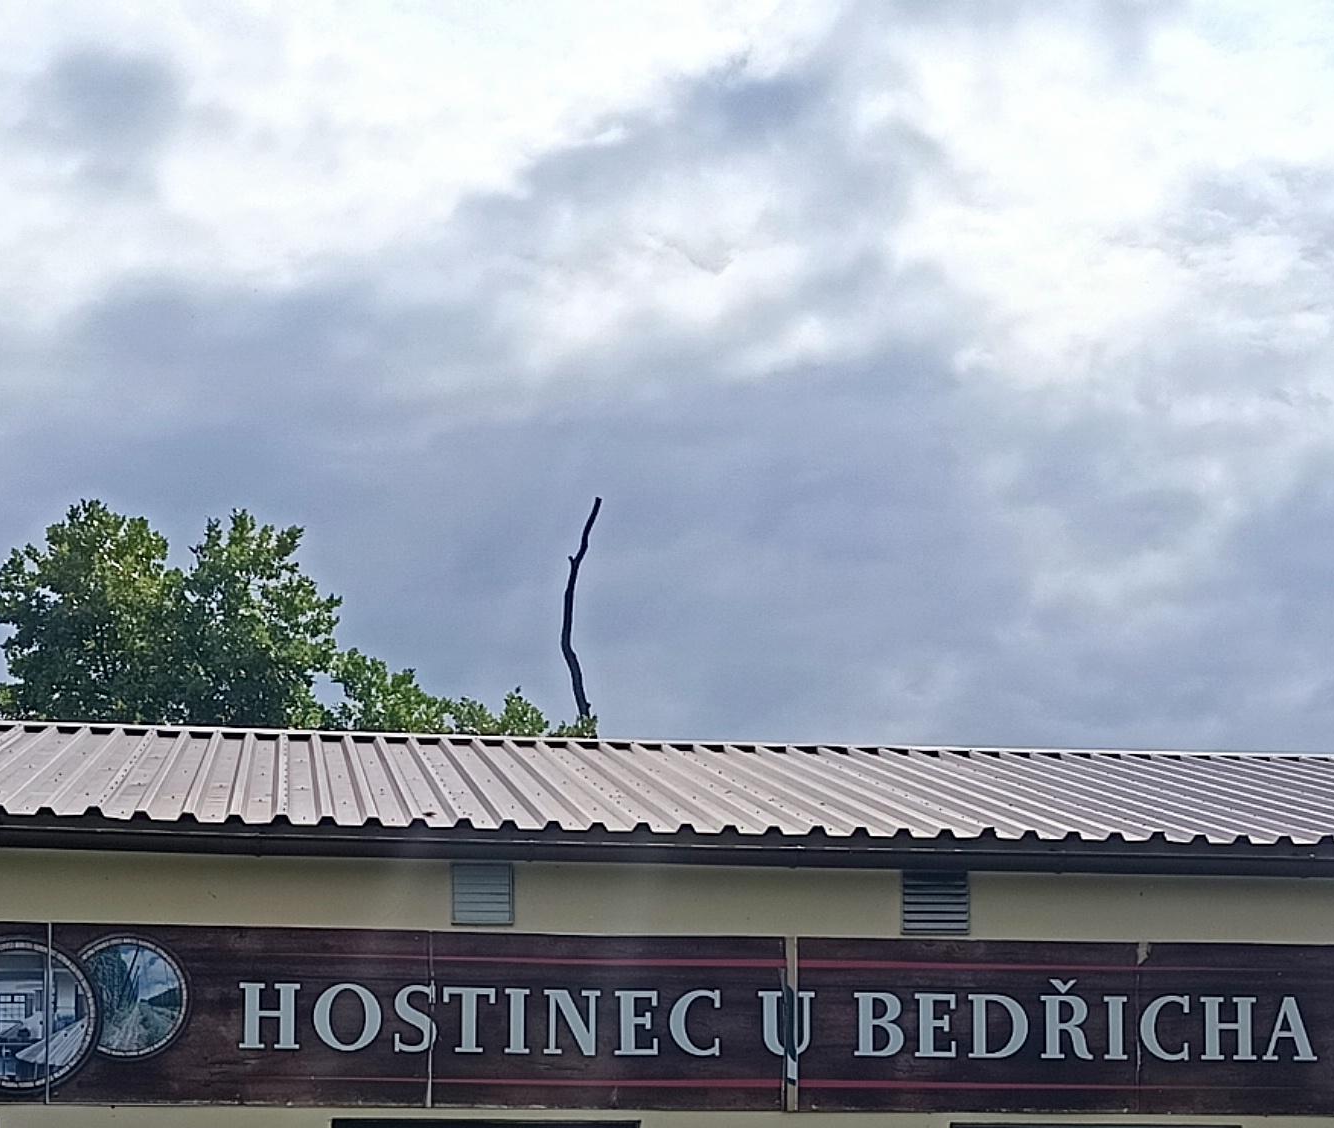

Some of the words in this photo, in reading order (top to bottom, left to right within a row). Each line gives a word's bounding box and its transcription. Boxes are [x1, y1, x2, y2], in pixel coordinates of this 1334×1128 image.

[238, 982, 721, 1057] HOSTINEC
[757, 990, 815, 1060] U
[853, 979, 1318, 1062] BEDŘICHA
